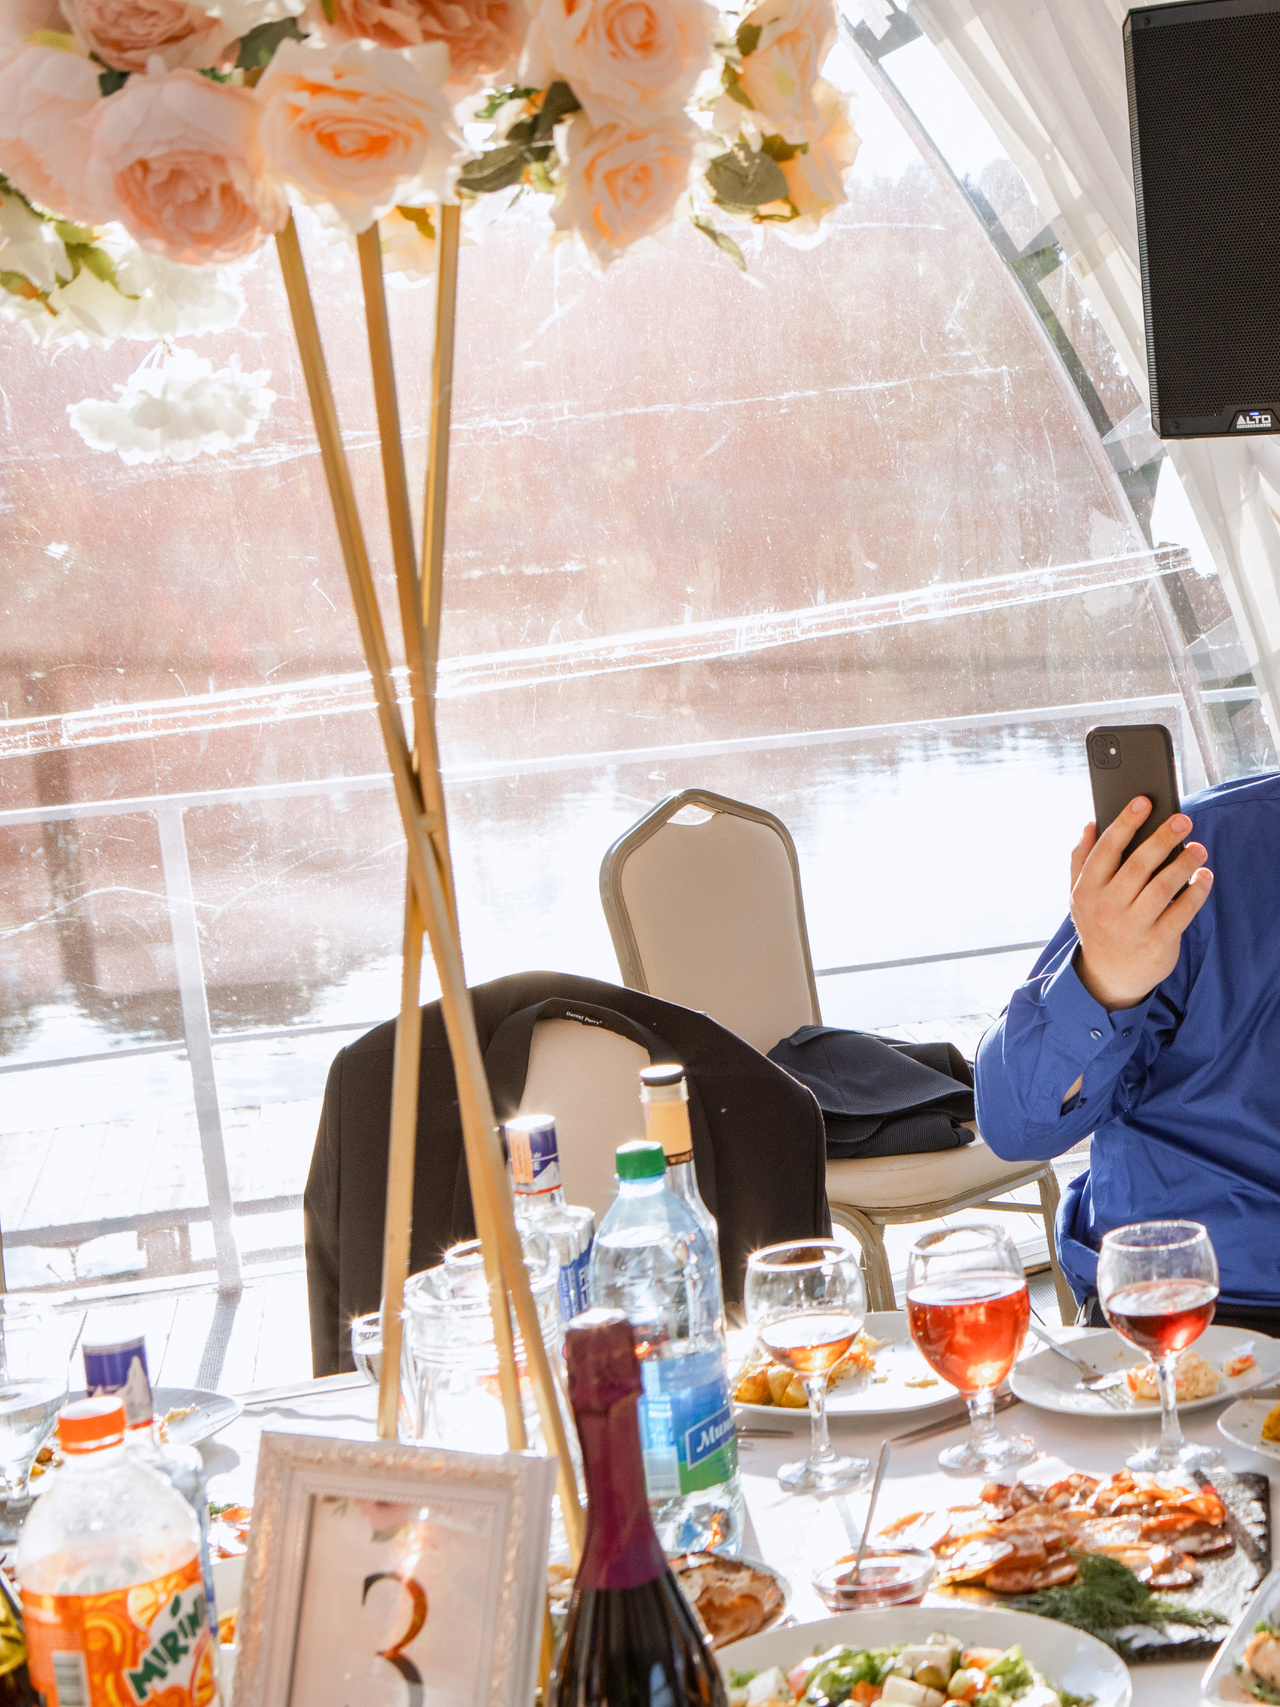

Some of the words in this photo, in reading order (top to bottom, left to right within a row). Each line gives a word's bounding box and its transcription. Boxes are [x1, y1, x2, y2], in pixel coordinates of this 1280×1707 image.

[1236, 414, 1271, 424] ALTO
[129, 1594, 205, 1699] MIRIN
[362, 1571, 428, 1707] 3
